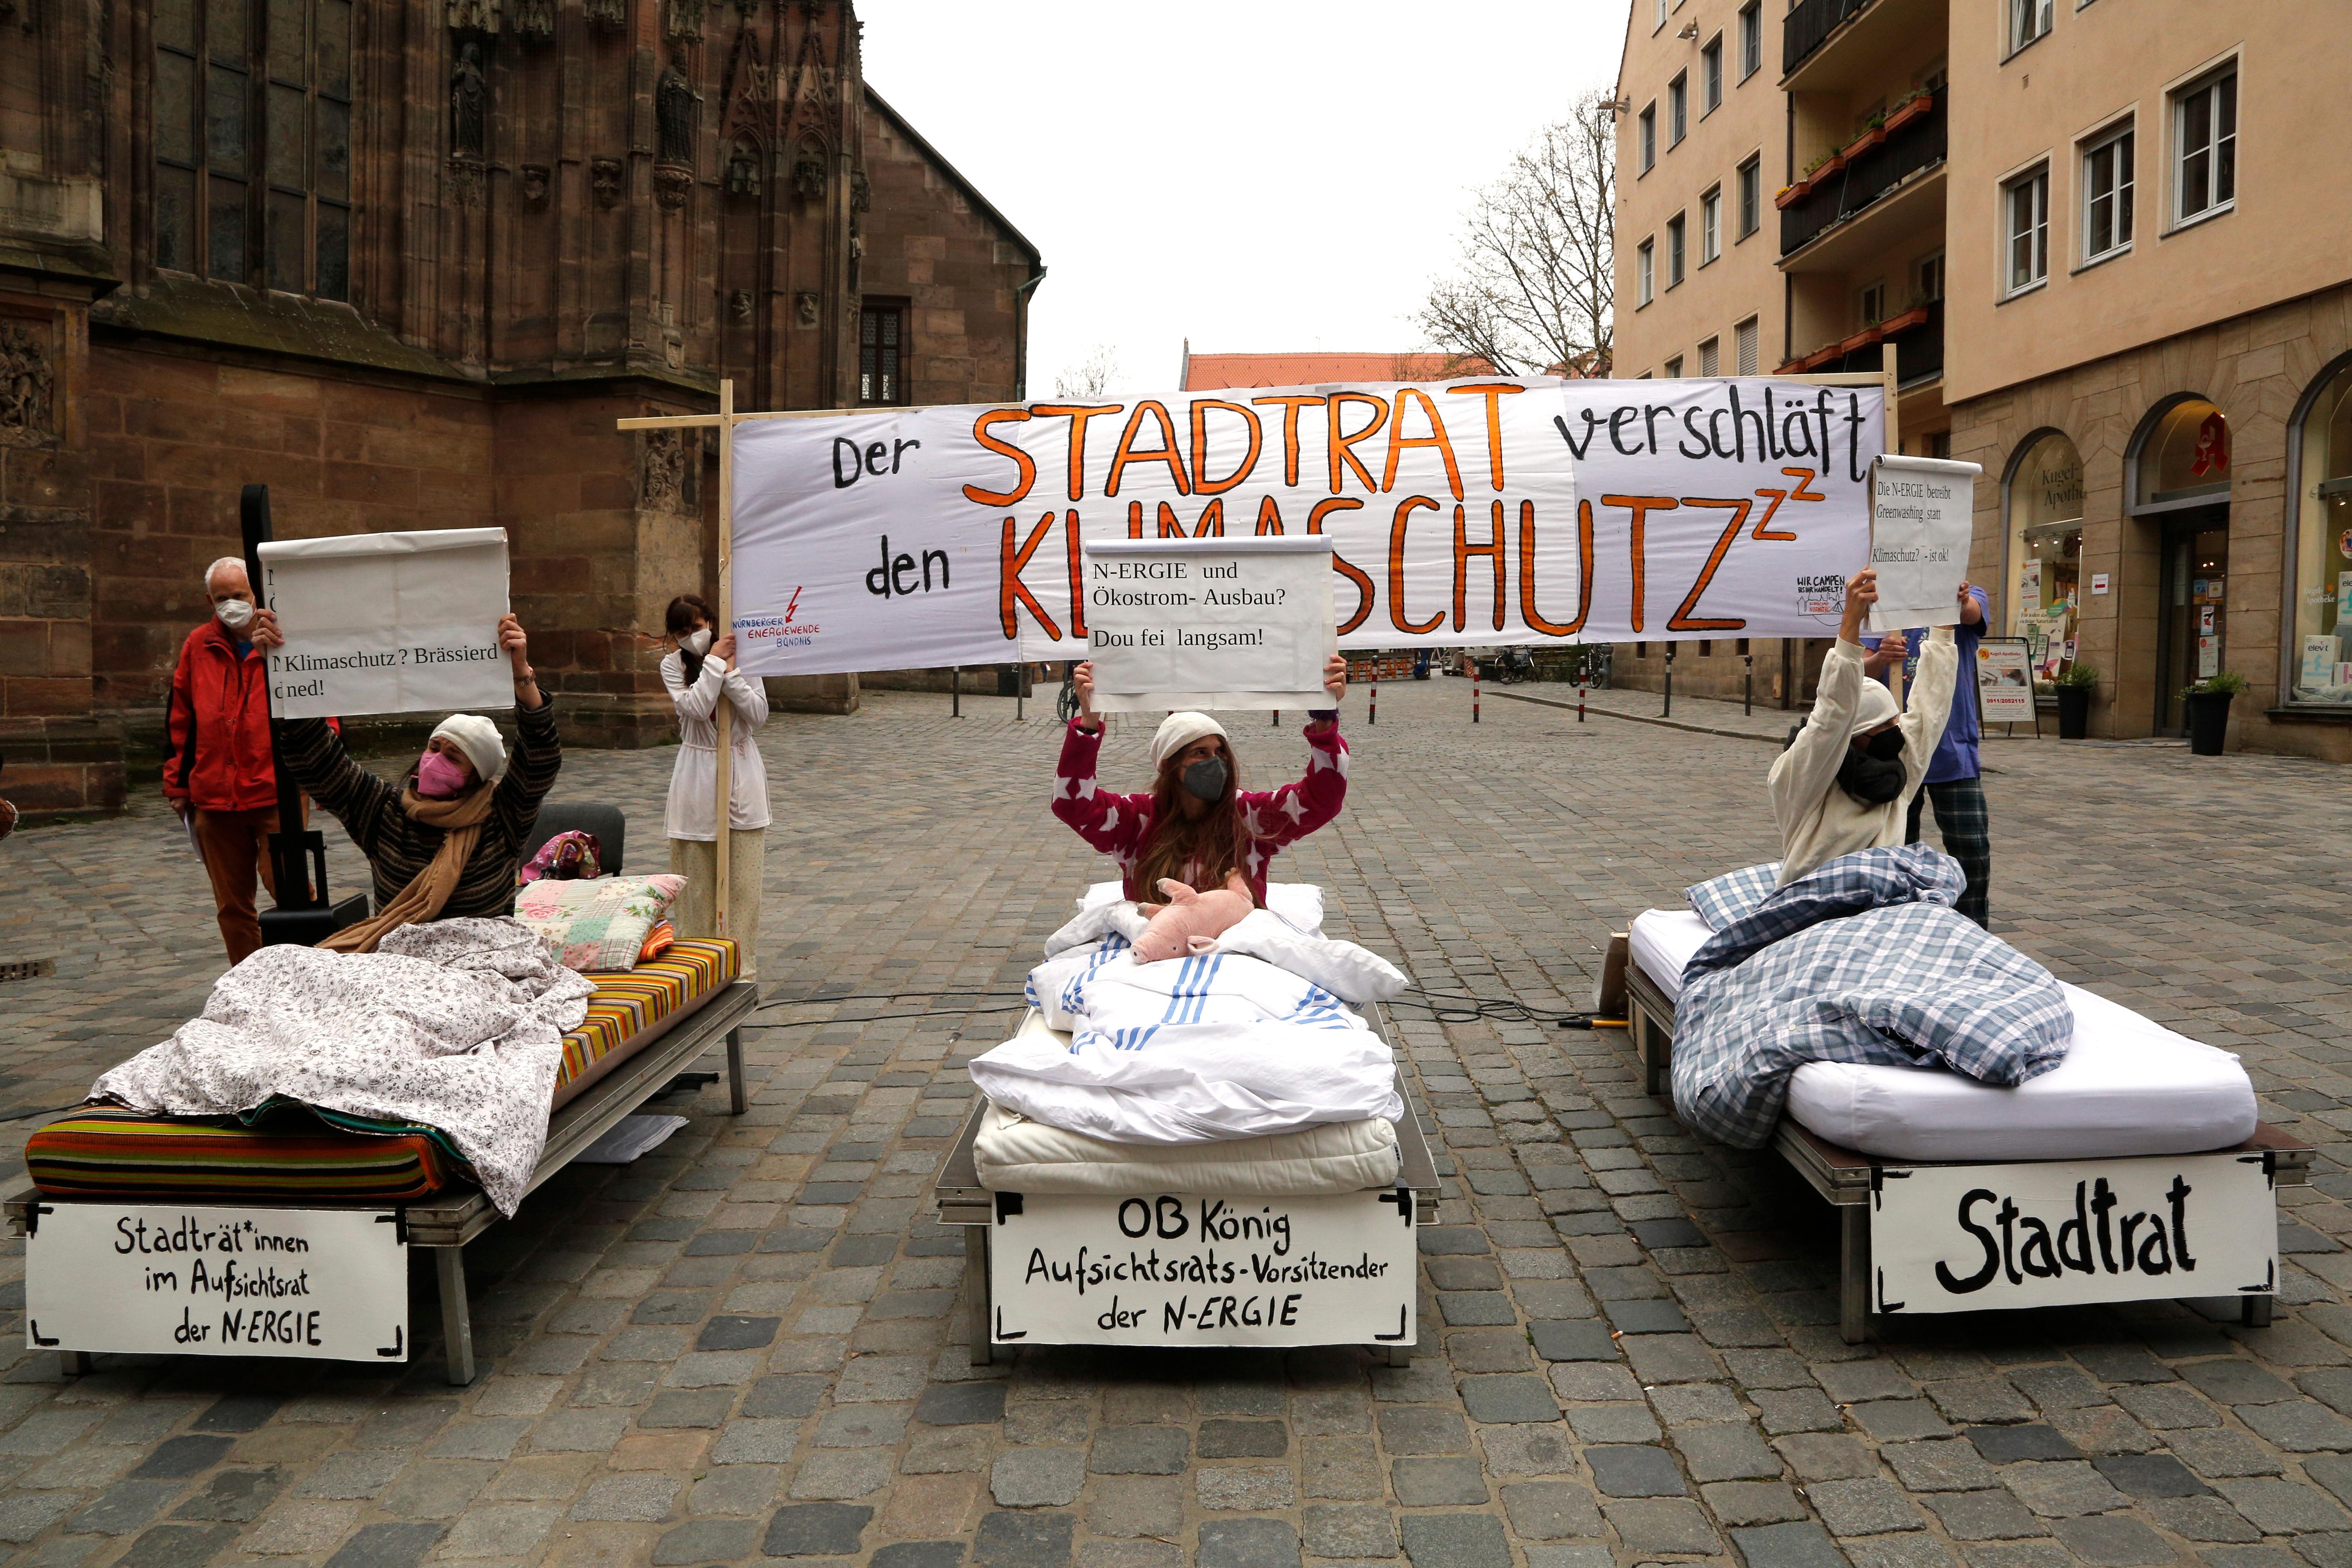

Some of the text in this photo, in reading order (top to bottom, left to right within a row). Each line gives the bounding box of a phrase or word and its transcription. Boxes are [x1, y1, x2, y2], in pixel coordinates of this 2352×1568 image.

[833, 383, 1866, 507] Der STADTRAT verschläft
[1878, 481, 1890, 496] Die
[1892, 483, 1923, 498] N-ERGIE
[1927, 485, 1951, 499] betreibt
[1876, 504, 1941, 523] Greenwashing statt
[1872, 548, 1919, 562] Klimaschutz?
[1939, 548, 1949, 562] ok!
[866, 535, 949, 599] den
[1093, 562, 1238, 579] N-ERGIE und
[1797, 575, 1845, 586] WIR CAMPEN
[1093, 586, 1285, 606] Ökostrom- Ausbau?
[733, 617, 783, 629] NÜRNBERGER
[748, 624, 820, 638] ENERGIEWENDE
[777, 636, 811, 647] BÜNDNIS
[1093, 629, 1263, 650] Dou fei langsam!
[414, 643, 498, 664] Brässierd
[287, 680, 324, 697] ned!
[1118, 1196, 1291, 1255] OB König
[1935, 1174, 2196, 1294] Stadtrat
[145, 1258, 310, 1302] im Aufsichtsrat
[1026, 1246, 1388, 1295] Aufsichtsrats-Vorsitzender
[1097, 1294, 1303, 1334] der N-ERGIE
[174, 1306, 211, 1344] der
